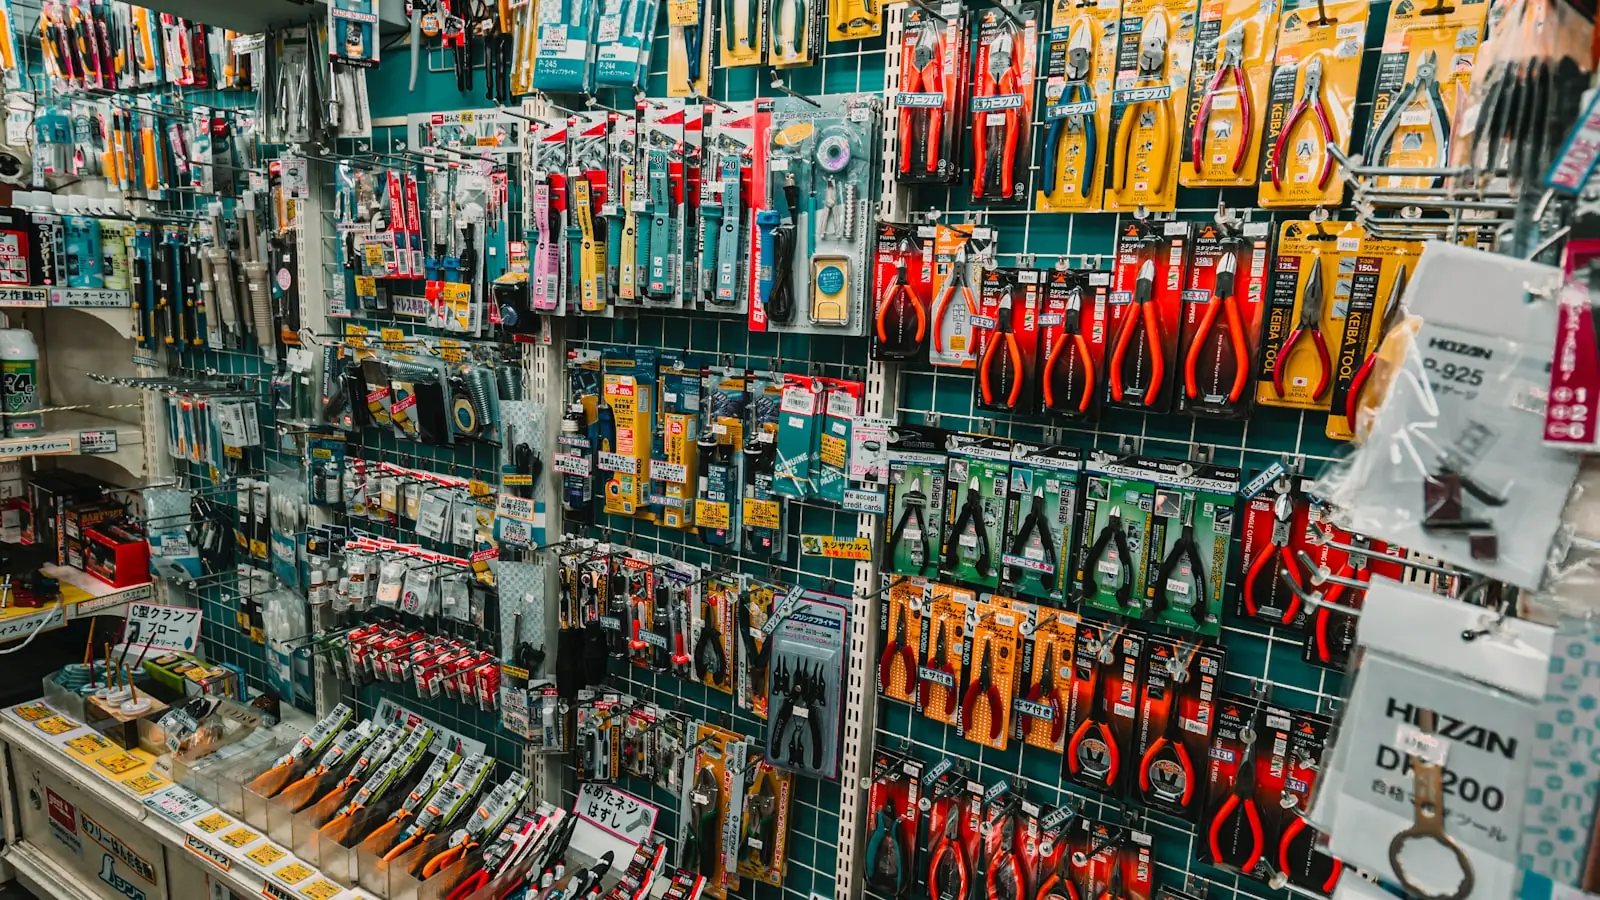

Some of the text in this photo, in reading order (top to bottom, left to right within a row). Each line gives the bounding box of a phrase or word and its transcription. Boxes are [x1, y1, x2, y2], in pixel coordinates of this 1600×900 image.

[538, 59, 558, 69] P-245
[899, 94, 939, 105] 強力ニッパ
[975, 96, 1020, 109] 強力ニッパ
[1271, 103, 1284, 138] KEIBA
[724, 161, 737, 170] 20
[1263, 308, 1283, 375] KEIBA TOOL
[1339, 311, 1361, 381] KEIBA TOOL
[1429, 337, 1493, 361] HOZAN
[775, 452, 809, 472] GNUINE
[899, 454, 937, 462] マイクロニッパー
[1158, 475, 1235, 490] ミニチュアロングノーズペンチ
[844, 491, 877, 502] We accept
[843, 502, 883, 512] credit cards.
[823, 541, 869, 552] ネジザウルス
[967, 606, 976, 632] TP
[921, 668, 953, 685] ギザ付き
[1014, 700, 1051, 717] ギザ付き
[1220, 713, 1241, 723] FUJIYA
[583, 783, 640, 815] なめたネジ
[587, 801, 621, 829] はずし
[1041, 806, 1072, 828] ギザ付き
